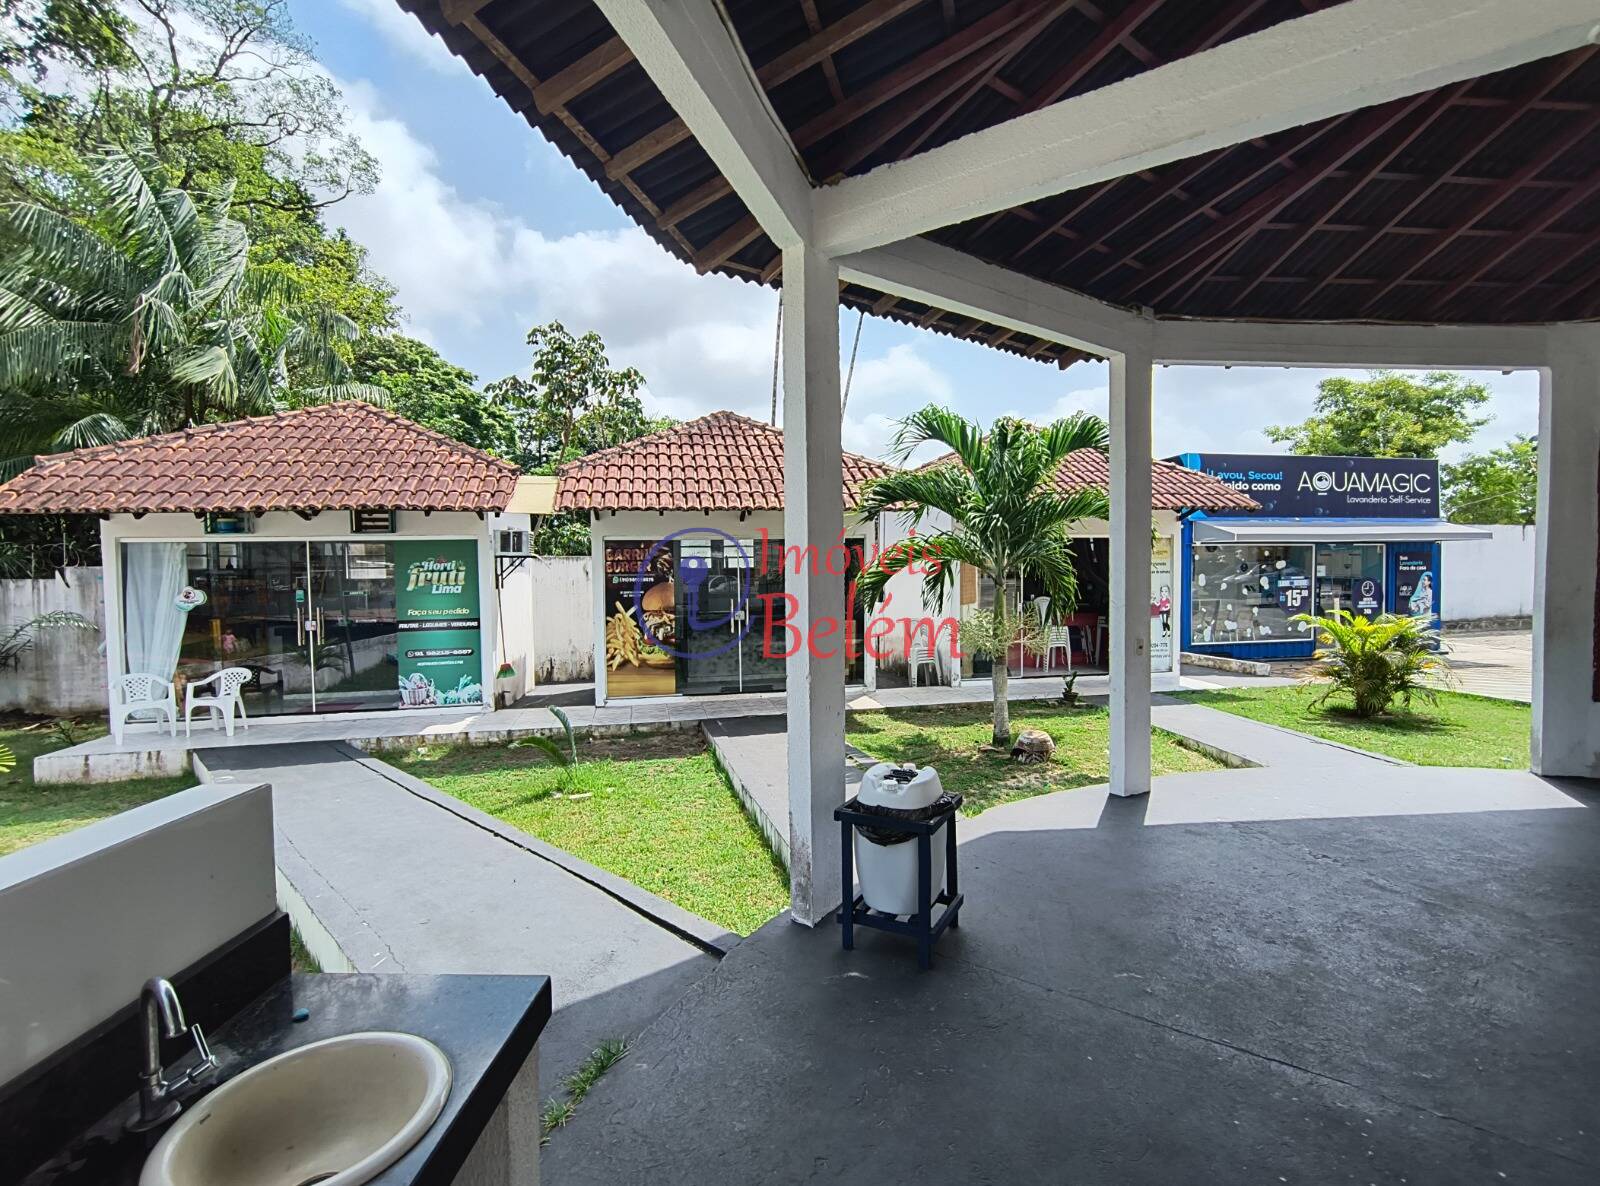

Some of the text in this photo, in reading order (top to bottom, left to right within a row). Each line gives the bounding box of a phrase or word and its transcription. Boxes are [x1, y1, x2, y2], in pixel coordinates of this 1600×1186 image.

[1248, 470, 1283, 480] Secou!
[1251, 482, 1281, 491] como
[1297, 471, 1431, 495] AQUAMAGIC
[1346, 495, 1431, 504] Lavanderia Self-Service
[422, 560, 456, 571] Horti
[406, 566, 466, 592] fruti
[432, 584, 462, 594] Lima
[1285, 589, 1302, 607] 15
[442, 607, 470, 616] pedido
